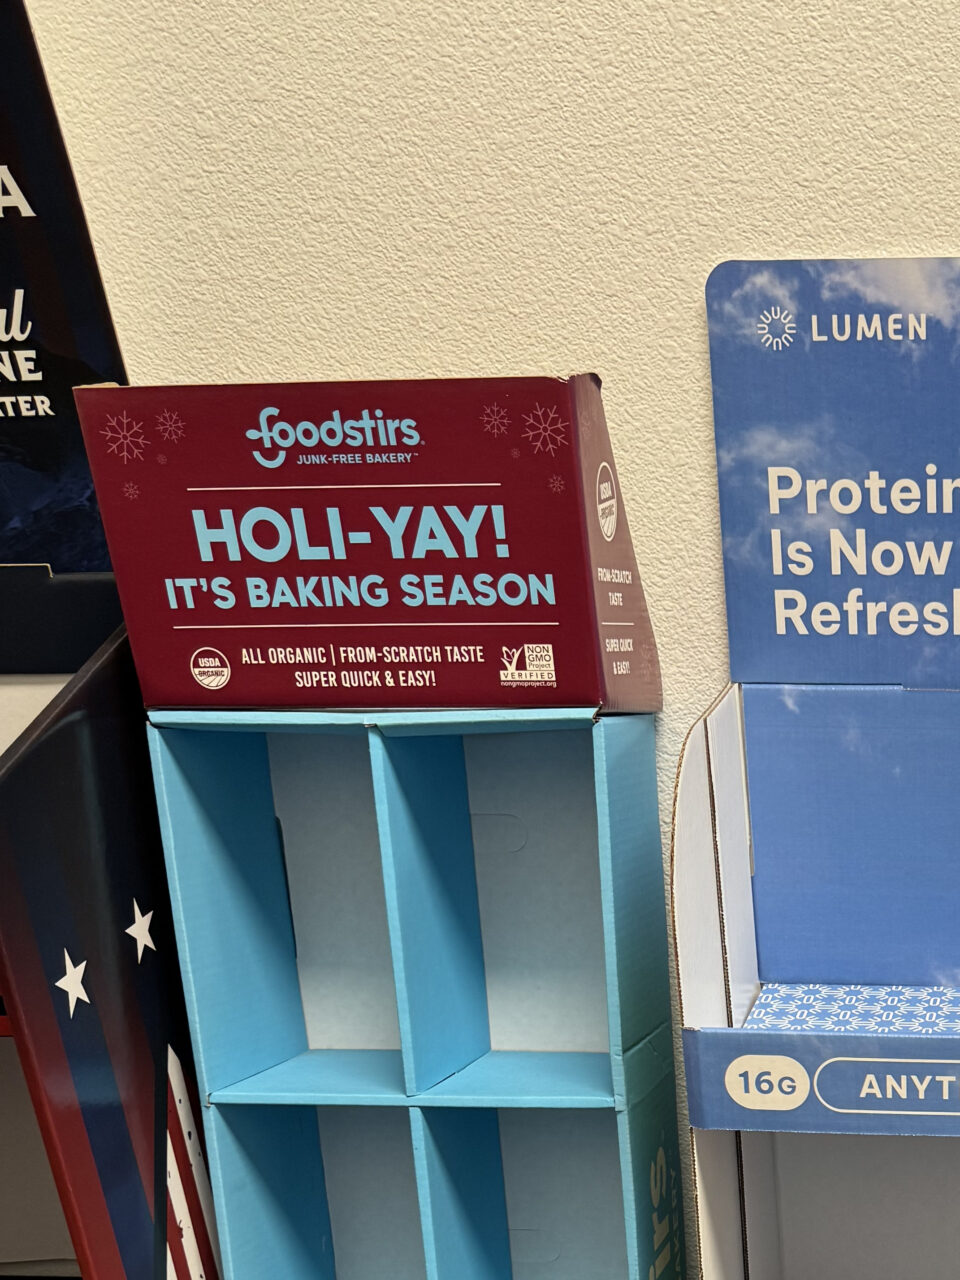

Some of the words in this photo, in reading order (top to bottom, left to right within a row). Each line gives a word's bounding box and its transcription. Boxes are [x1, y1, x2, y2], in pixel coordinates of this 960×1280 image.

[811, 313, 928, 342] LUMEN
[296, 453, 362, 465] JUNK-FREE
[191, 504, 510, 563] HOLI-YAY!
[771, 528, 814, 576] Is
[829, 528, 954, 576] Now
[247, 574, 390, 609] BAKING
[401, 572, 557, 607] SEASON
[608, 592, 623, 606] TASTE
[241, 648, 266, 665] ALL
[268, 647, 327, 664] ORGANIC
[339, 646, 442, 664] FROM-SCRATCH
[444, 645, 485, 663] TASTE
[526, 645, 550, 654] NON
[198, 657, 221, 667] USDA
[527, 654, 552, 663] GMO
[528, 662, 552, 670] Project
[197, 669, 226, 678] ORGANIC
[295, 671, 338, 688] SUPER
[341, 670, 382, 688] QUICK
[384, 670, 396, 687] &
[398, 670, 437, 687] EASY!
[502, 672, 554, 680] VERIFIED
[738, 1070, 797, 1096] 16G
